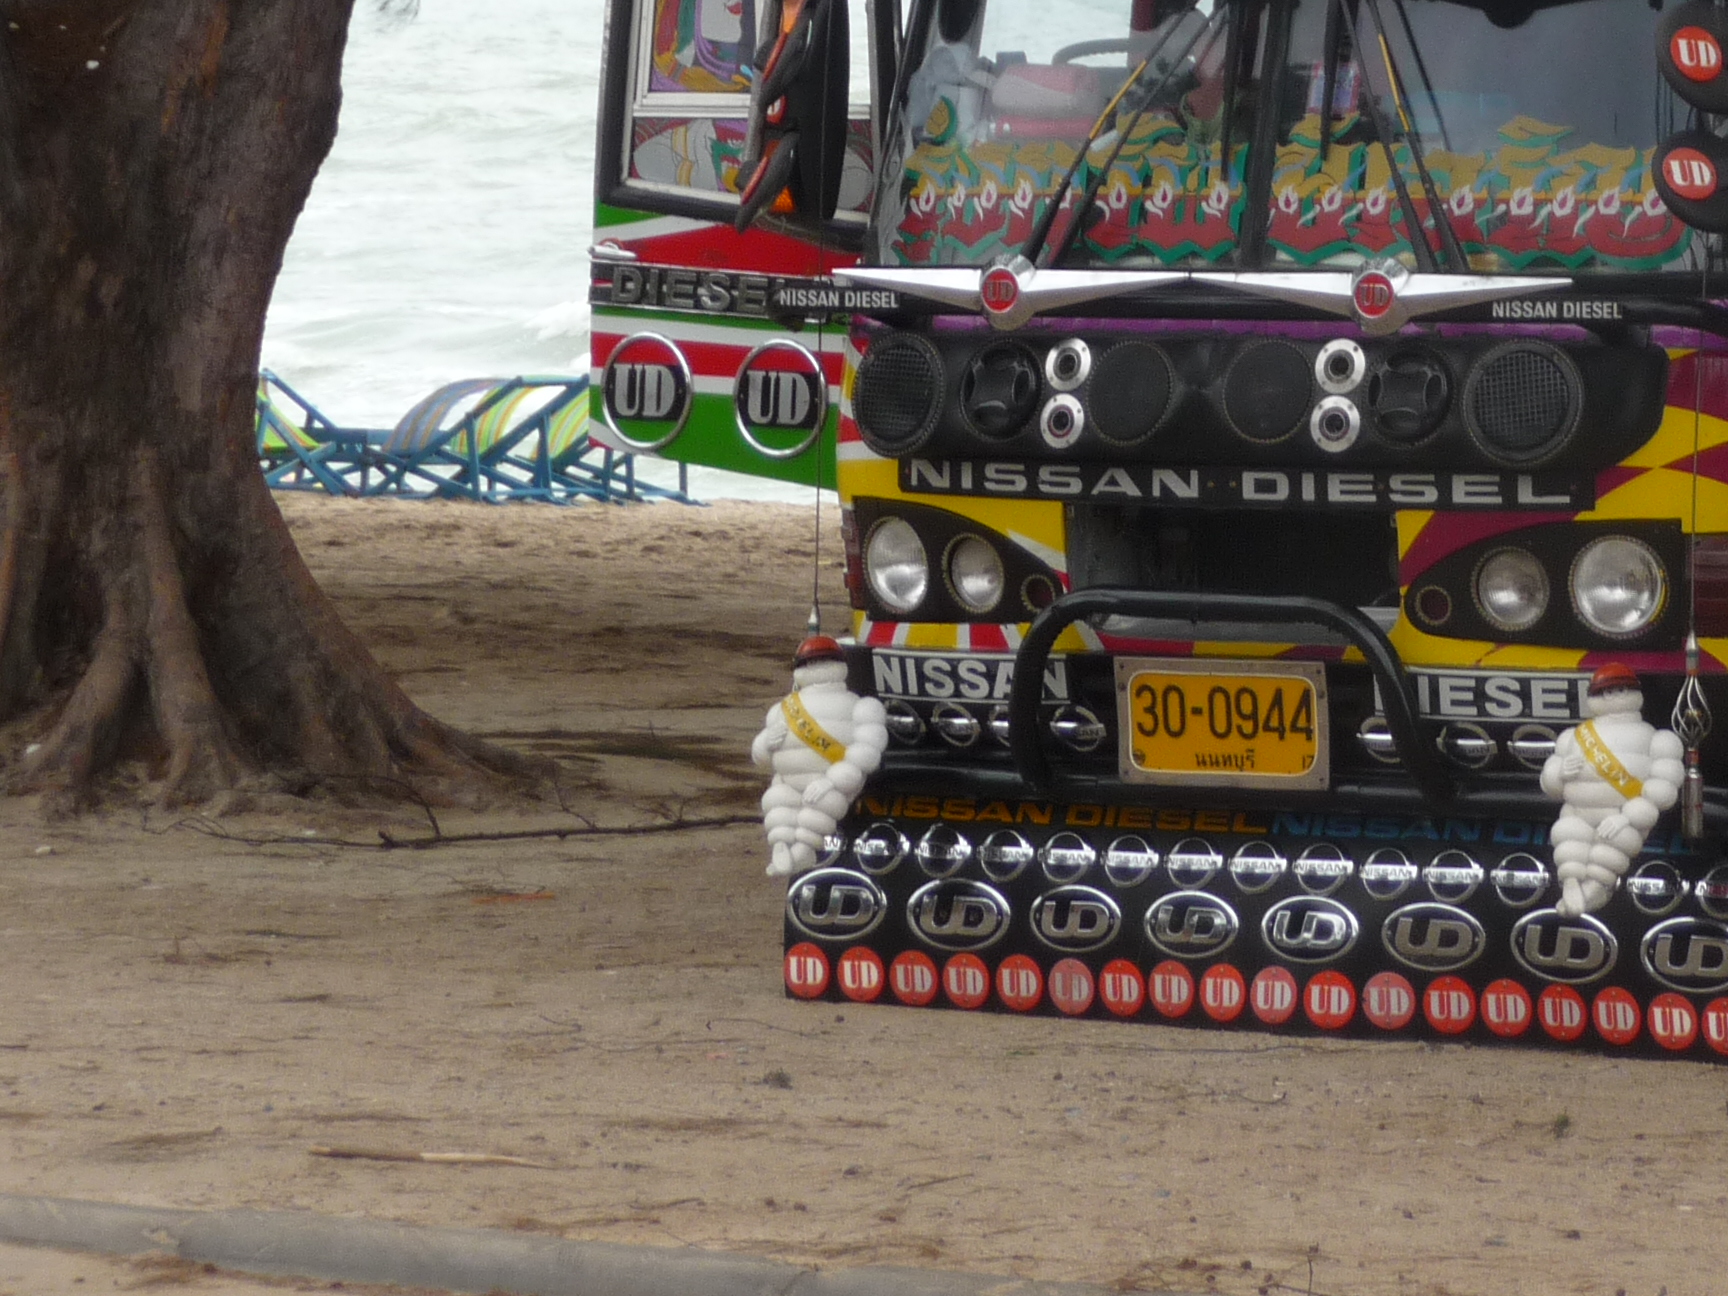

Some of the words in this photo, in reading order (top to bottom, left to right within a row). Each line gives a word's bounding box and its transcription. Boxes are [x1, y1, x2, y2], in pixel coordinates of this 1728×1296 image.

[1677, 39, 1716, 67] UD
[1670, 160, 1711, 186] UD
[780, 290, 839, 307] NISSAN
[846, 291, 898, 308] DIESEL
[984, 281, 1014, 303] UD
[1361, 282, 1390, 307] UD
[1492, 301, 1557, 318] NISSAN
[1563, 302, 1622, 319] DIESEL
[614, 364, 676, 417] UD
[748, 371, 810, 424] UD
[910, 459, 1198, 499] NISSAN
[1242, 471, 1571, 503] DIESEL
[1135, 684, 1314, 742] 30-0944
[1195, 749, 1255, 771] นนทบุรี
[856, 799, 1052, 825] NISSAN
[1066, 804, 1267, 833] DIESEL
[1274, 814, 1481, 840] NISSAN
[1102, 851, 1153, 866] NISSAN
[1166, 855, 1217, 869] NISSAN
[1230, 858, 1278, 873] NISSAN
[1294, 861, 1345, 875] NISSAN
[1360, 866, 1413, 880] NISSAN
[1423, 868, 1478, 882] NISSAN
[801, 884, 875, 925] UD
[919, 894, 999, 936] UD
[1041, 900, 1110, 939] UD
[1155, 905, 1226, 944] UD
[1273, 910, 1347, 948] UD
[1396, 916, 1473, 957] UD
[1525, 923, 1604, 965] UD
[789, 956, 824, 984] UD
[843, 960, 879, 988] UD
[896, 965, 932, 994] UD
[948, 966, 984, 995] UD
[1002, 968, 1037, 997] UD
[1055, 971, 1088, 1001] UD
[1105, 972, 1139, 1002] UD
[1154, 974, 1189, 1003] UD
[1206, 978, 1240, 1006] UD
[1256, 981, 1292, 1010] UD
[1310, 986, 1350, 1014] UD
[1369, 988, 1408, 1016] UD
[1429, 990, 1469, 1020] UD
[1487, 994, 1526, 1023] UD
[1544, 998, 1581, 1027] UD
[1598, 1001, 1635, 1030] UD
[1653, 1007, 1691, 1036] UD
